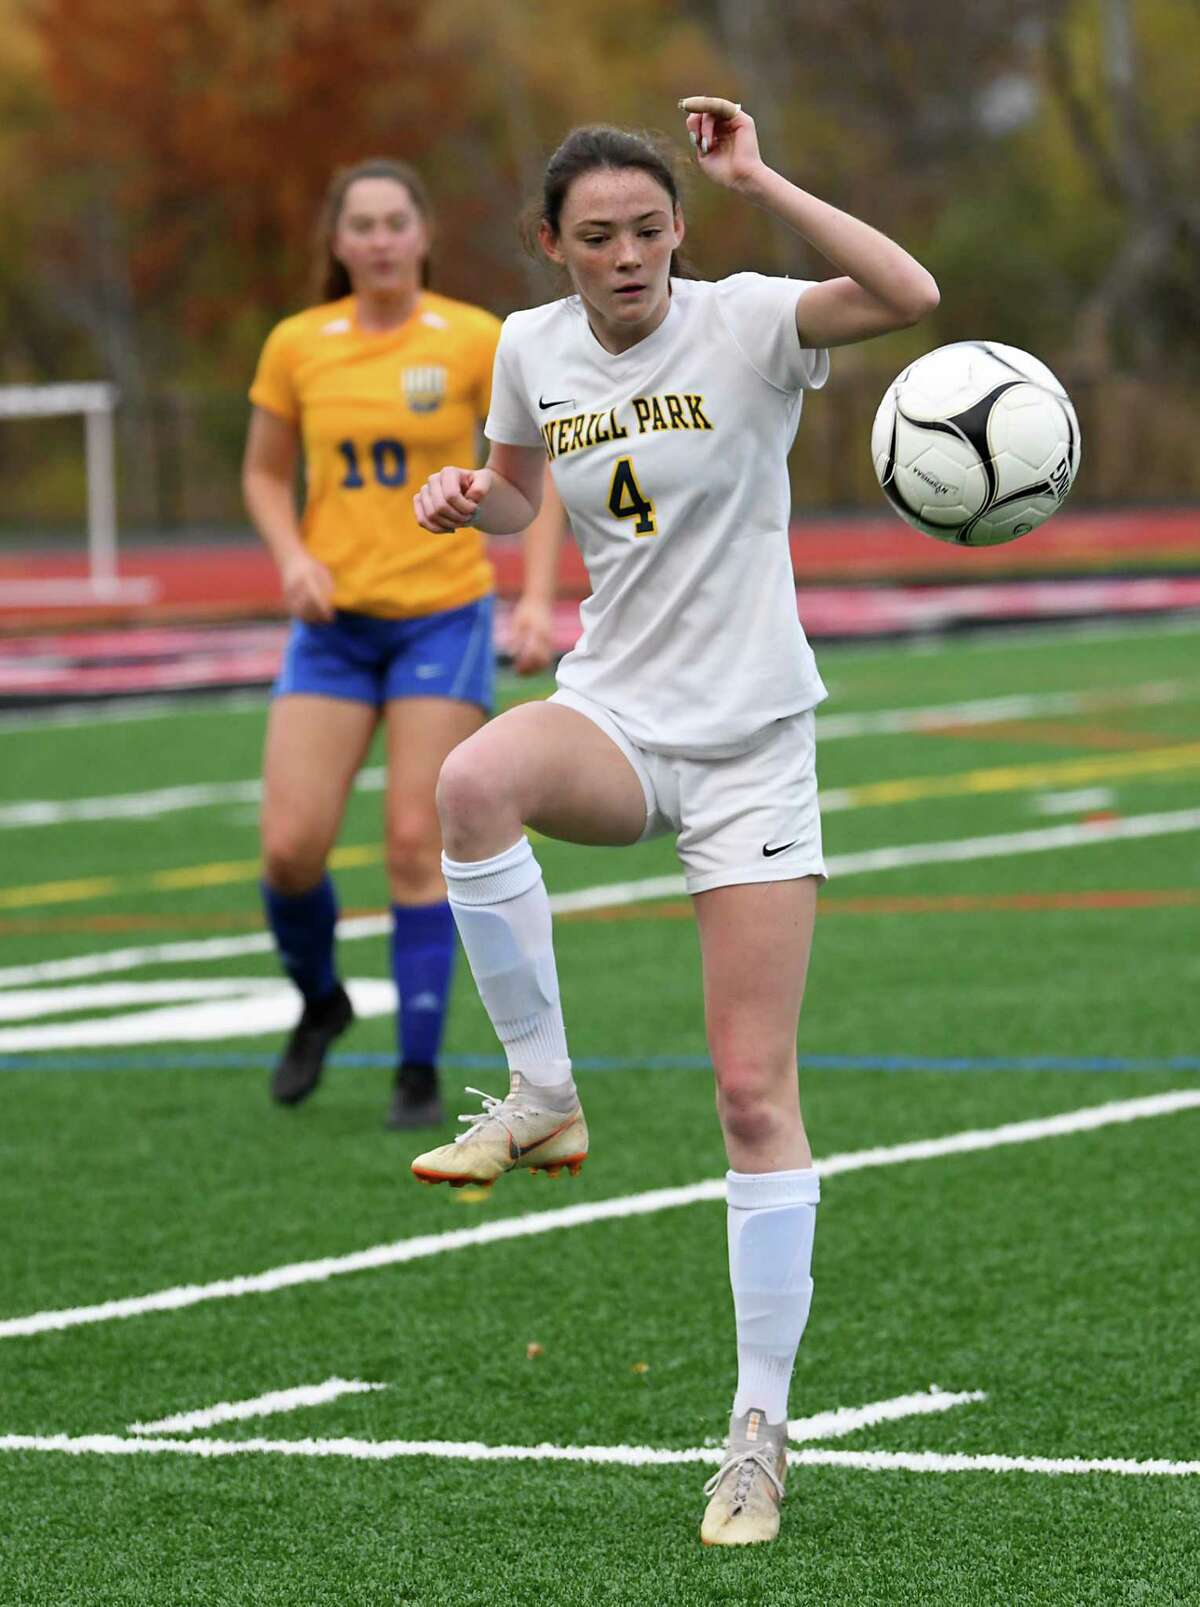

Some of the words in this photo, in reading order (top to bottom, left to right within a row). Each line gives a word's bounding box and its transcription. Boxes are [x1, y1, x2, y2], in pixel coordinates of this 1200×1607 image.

[540, 407, 628, 461] VERILL
[631, 394, 714, 433] PARK
[338, 438, 407, 489] 10
[607, 455, 657, 538] 4
